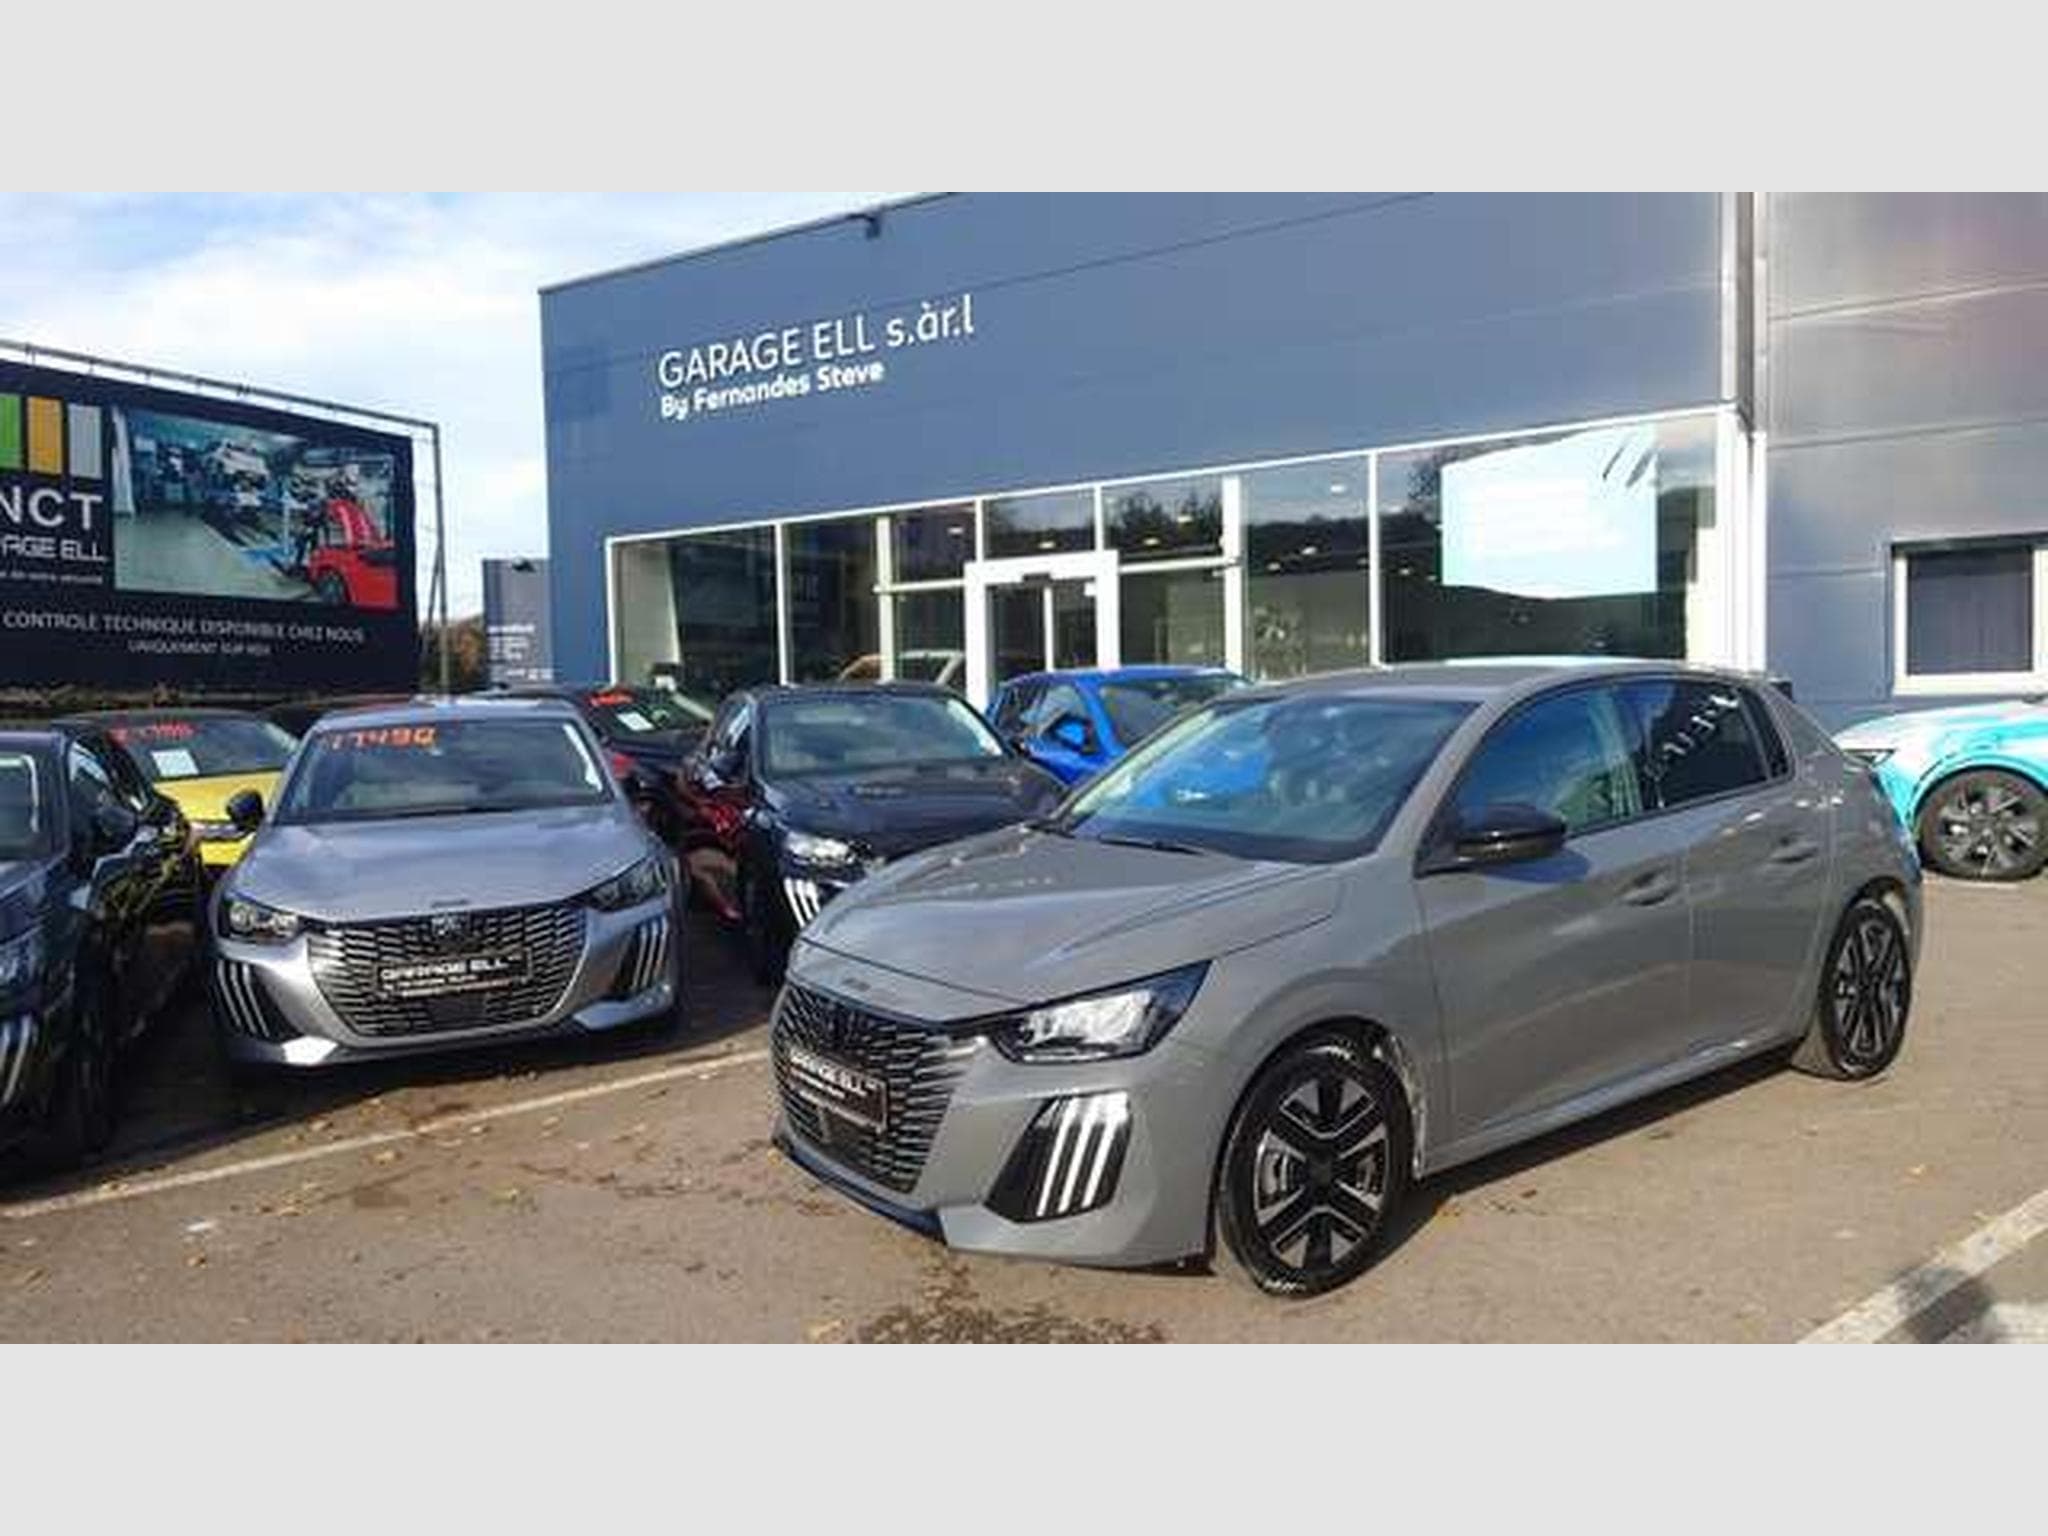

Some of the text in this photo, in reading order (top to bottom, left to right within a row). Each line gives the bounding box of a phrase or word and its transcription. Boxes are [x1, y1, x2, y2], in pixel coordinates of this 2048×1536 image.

[659, 327, 803, 388] GARAGE
[813, 313, 875, 360] ELL
[660, 359, 885, 421] By Fernandes Steve
